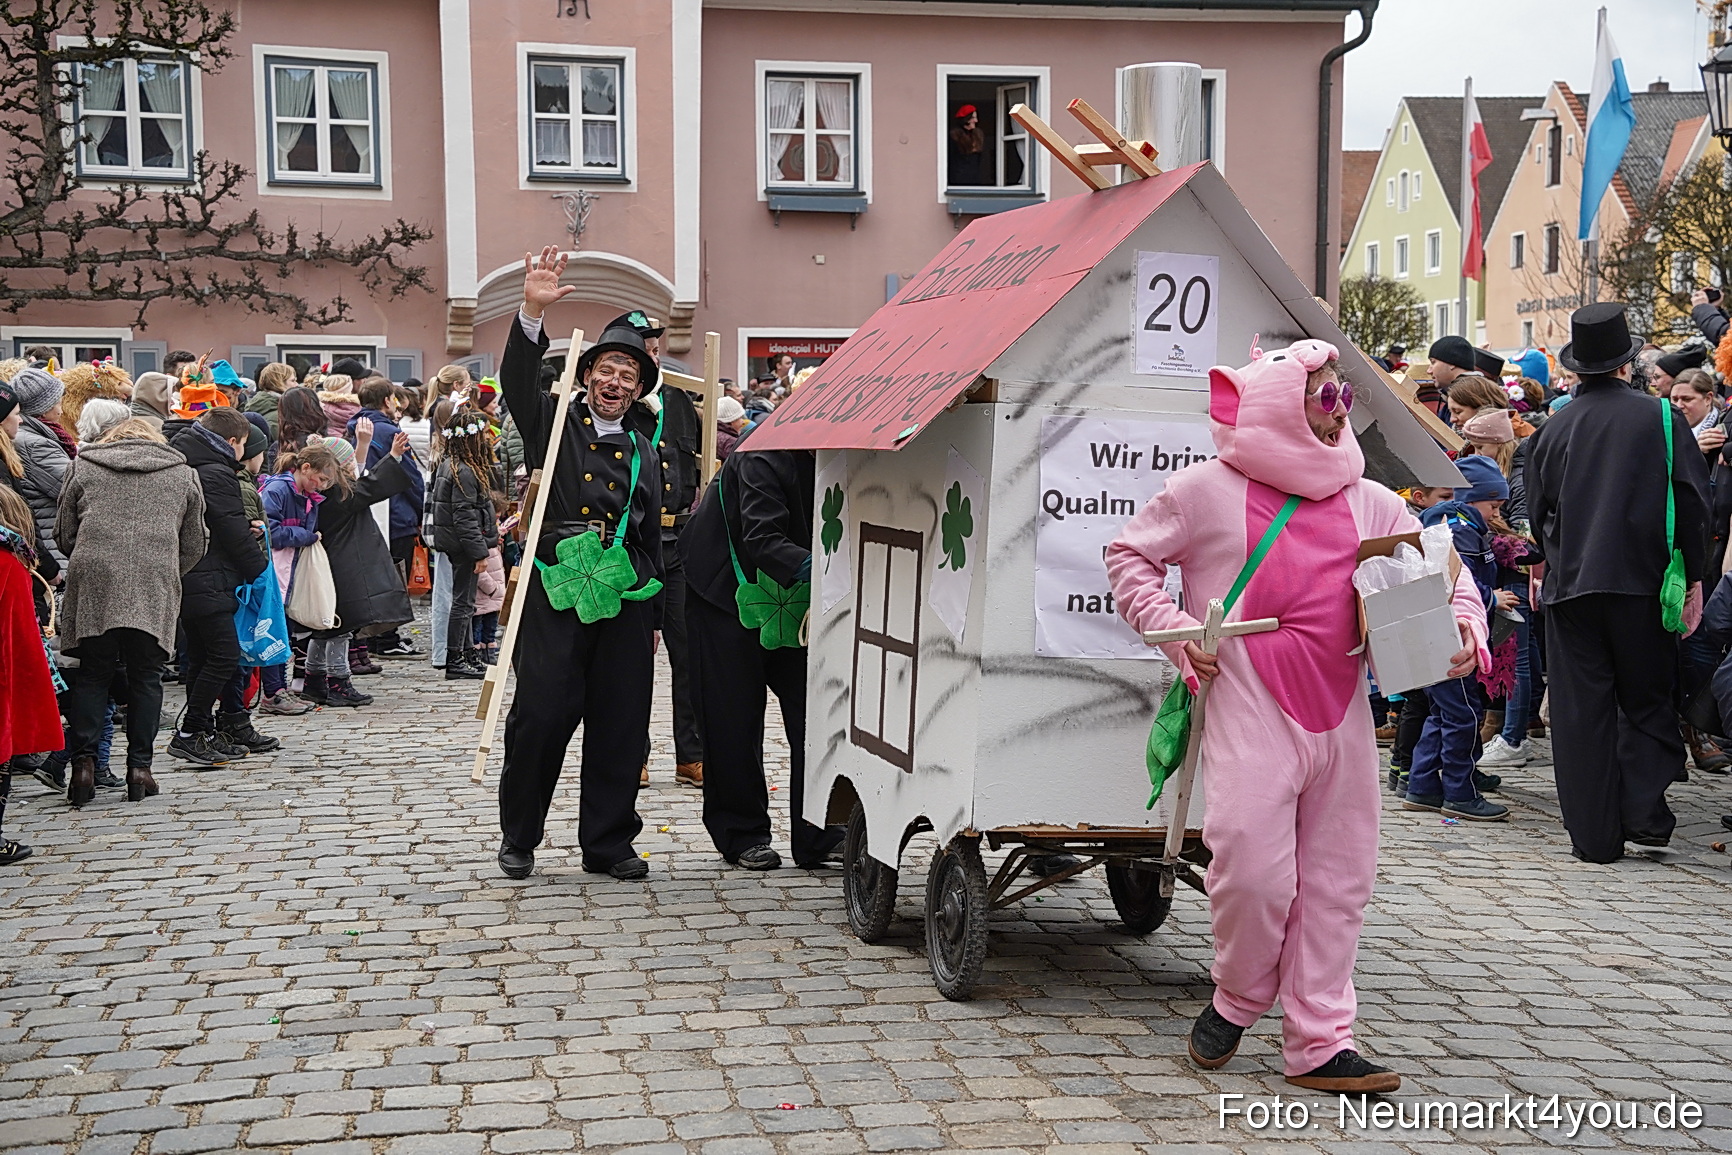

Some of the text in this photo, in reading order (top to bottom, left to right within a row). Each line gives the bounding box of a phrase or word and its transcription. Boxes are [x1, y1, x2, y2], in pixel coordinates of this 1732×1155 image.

[1144, 273, 1210, 334] 20
[774, 326, 979, 434] Glücksbringer
[1090, 442, 1143, 469] Wir
[1042, 489, 1135, 521] Qualm
